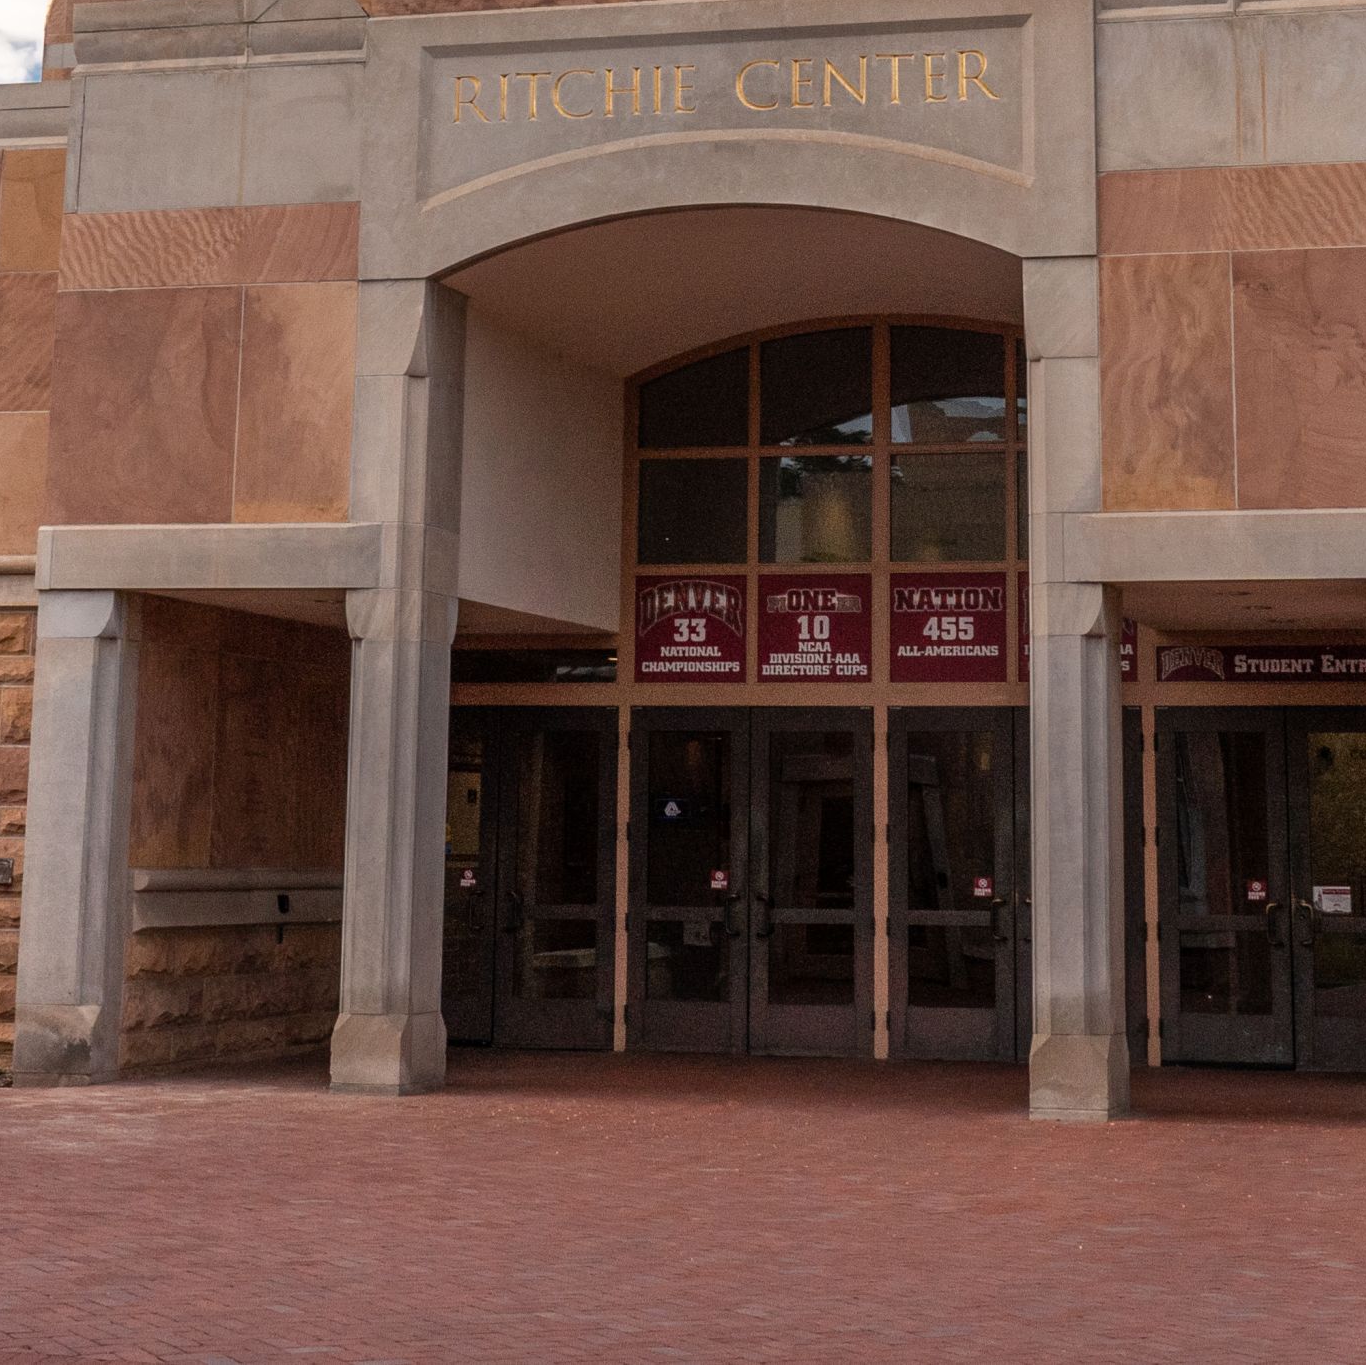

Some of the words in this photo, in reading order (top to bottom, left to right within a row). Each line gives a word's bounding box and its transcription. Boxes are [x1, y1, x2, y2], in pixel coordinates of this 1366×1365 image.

[451, 63, 698, 123] RITCHIE
[734, 48, 1000, 111] CENTER
[639, 579, 743, 637] DENVER
[894, 586, 1003, 612] NATION
[674, 618, 706, 642] 33
[797, 615, 830, 640] 10
[922, 617, 975, 641] 455
[660, 646, 721, 657] NATIONAL
[769, 653, 824, 664] DIVISION
[826, 653, 860, 664] I-AAA
[798, 642, 831, 652] NCAA
[897, 645, 999, 656] ALL-AMERICANS
[641, 661, 740, 672] CHAMPIONSHIPS
[762, 664, 833, 676] DIRECTORS'
[836, 665, 868, 676] CUPS
[1161, 646, 1225, 681] DENVER
